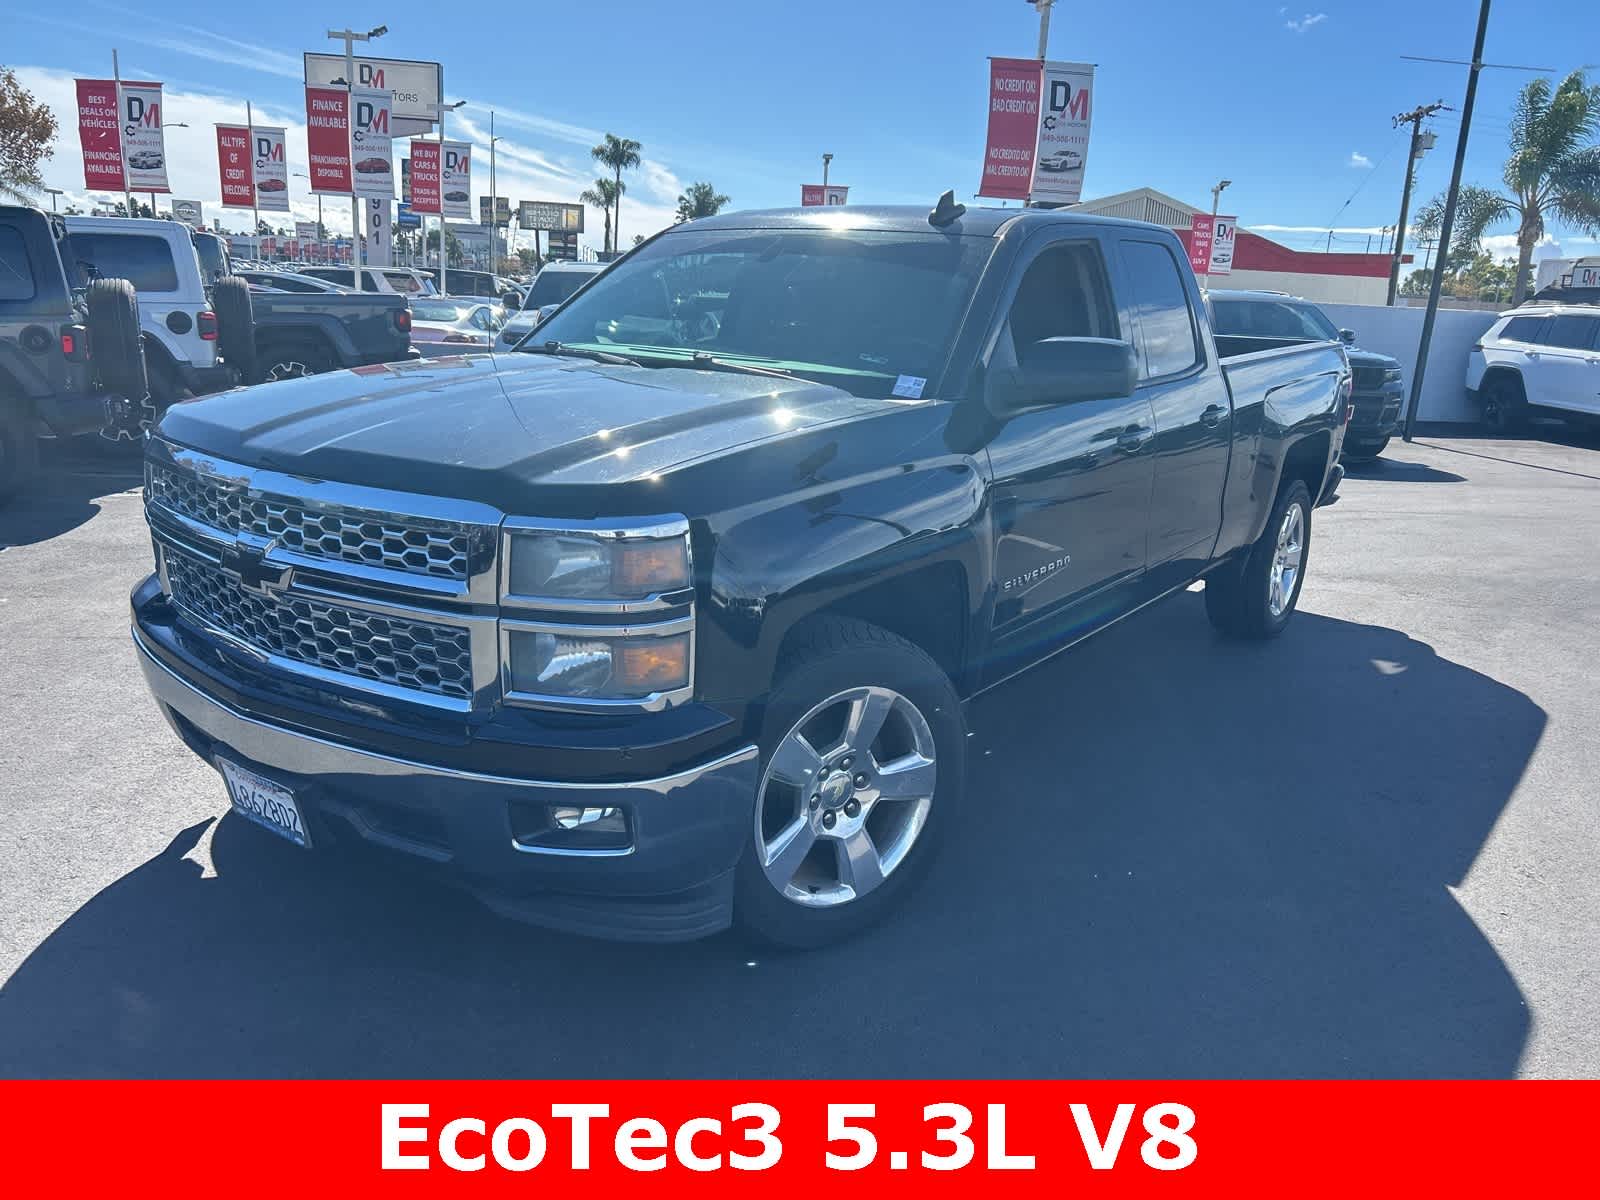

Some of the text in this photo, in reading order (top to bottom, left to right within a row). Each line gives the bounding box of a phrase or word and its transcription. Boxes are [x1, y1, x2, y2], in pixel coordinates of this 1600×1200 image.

[995, 79, 1004, 91] NO
[1004, 80, 1025, 93] CREDIT
[88, 95, 106, 104] BEST
[312, 99, 343, 112] FINANCE
[1050, 80, 1089, 121] DM
[80, 107, 117, 117] DEALS ON
[126, 96, 160, 129] DM
[992, 99, 1005, 113] BAD
[1005, 100, 1025, 114] CREDIT
[81, 119, 117, 129] VEHICLES
[309, 116, 347, 129] AVAILABLE
[357, 102, 388, 134] DM
[221, 136, 246, 148] ALL TYPE
[84, 151, 121, 161] FINANCING
[257, 138, 284, 162] DM
[413, 149, 438, 159] WE BUY
[990, 148, 999, 159] NO
[999, 149, 1020, 160] CREDITO
[229, 152, 238, 163] OF
[87, 164, 121, 174] AVAILABLE
[414, 160, 431, 169] CARS
[225, 169, 245, 180] CREDIT
[413, 172, 438, 182] TRUCKS
[998, 165, 1020, 177] CREDITO
[223, 184, 251, 196] WELCOME
[413, 197, 439, 205] ACCEPTED
[1004, 554, 1071, 590] SILVERADO
